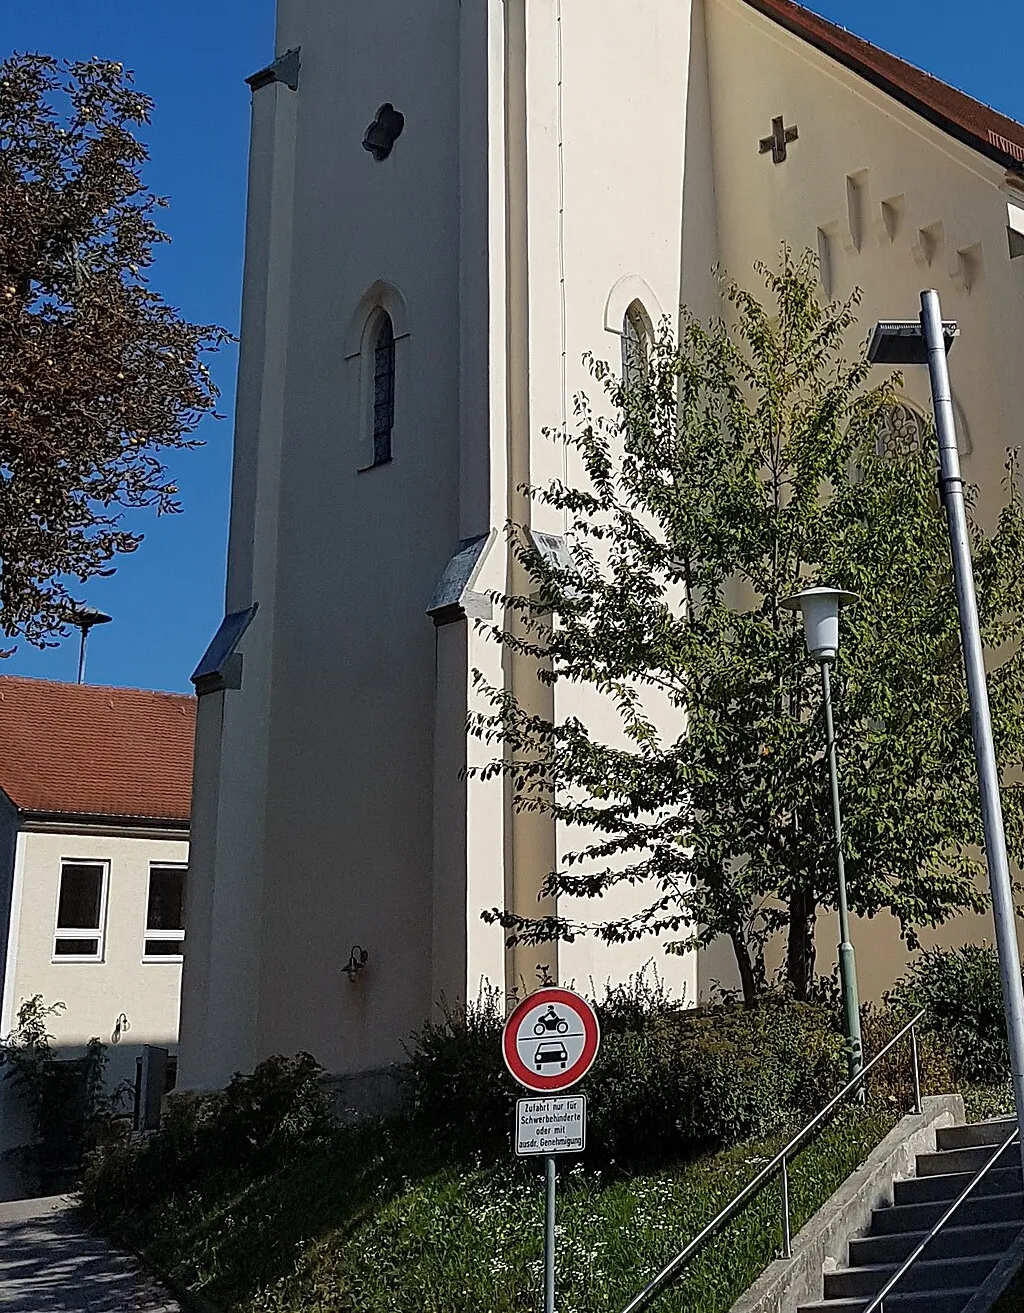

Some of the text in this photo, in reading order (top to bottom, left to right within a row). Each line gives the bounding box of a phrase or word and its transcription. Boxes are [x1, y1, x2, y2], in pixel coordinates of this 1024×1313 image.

[525, 1101, 577, 1112] Zufahrt nur für
[521, 1113, 581, 1124] Schwerbehinderte
[536, 1125, 566, 1136] oder mit
[519, 1136, 582, 1148] ausdr. Genehmigung
